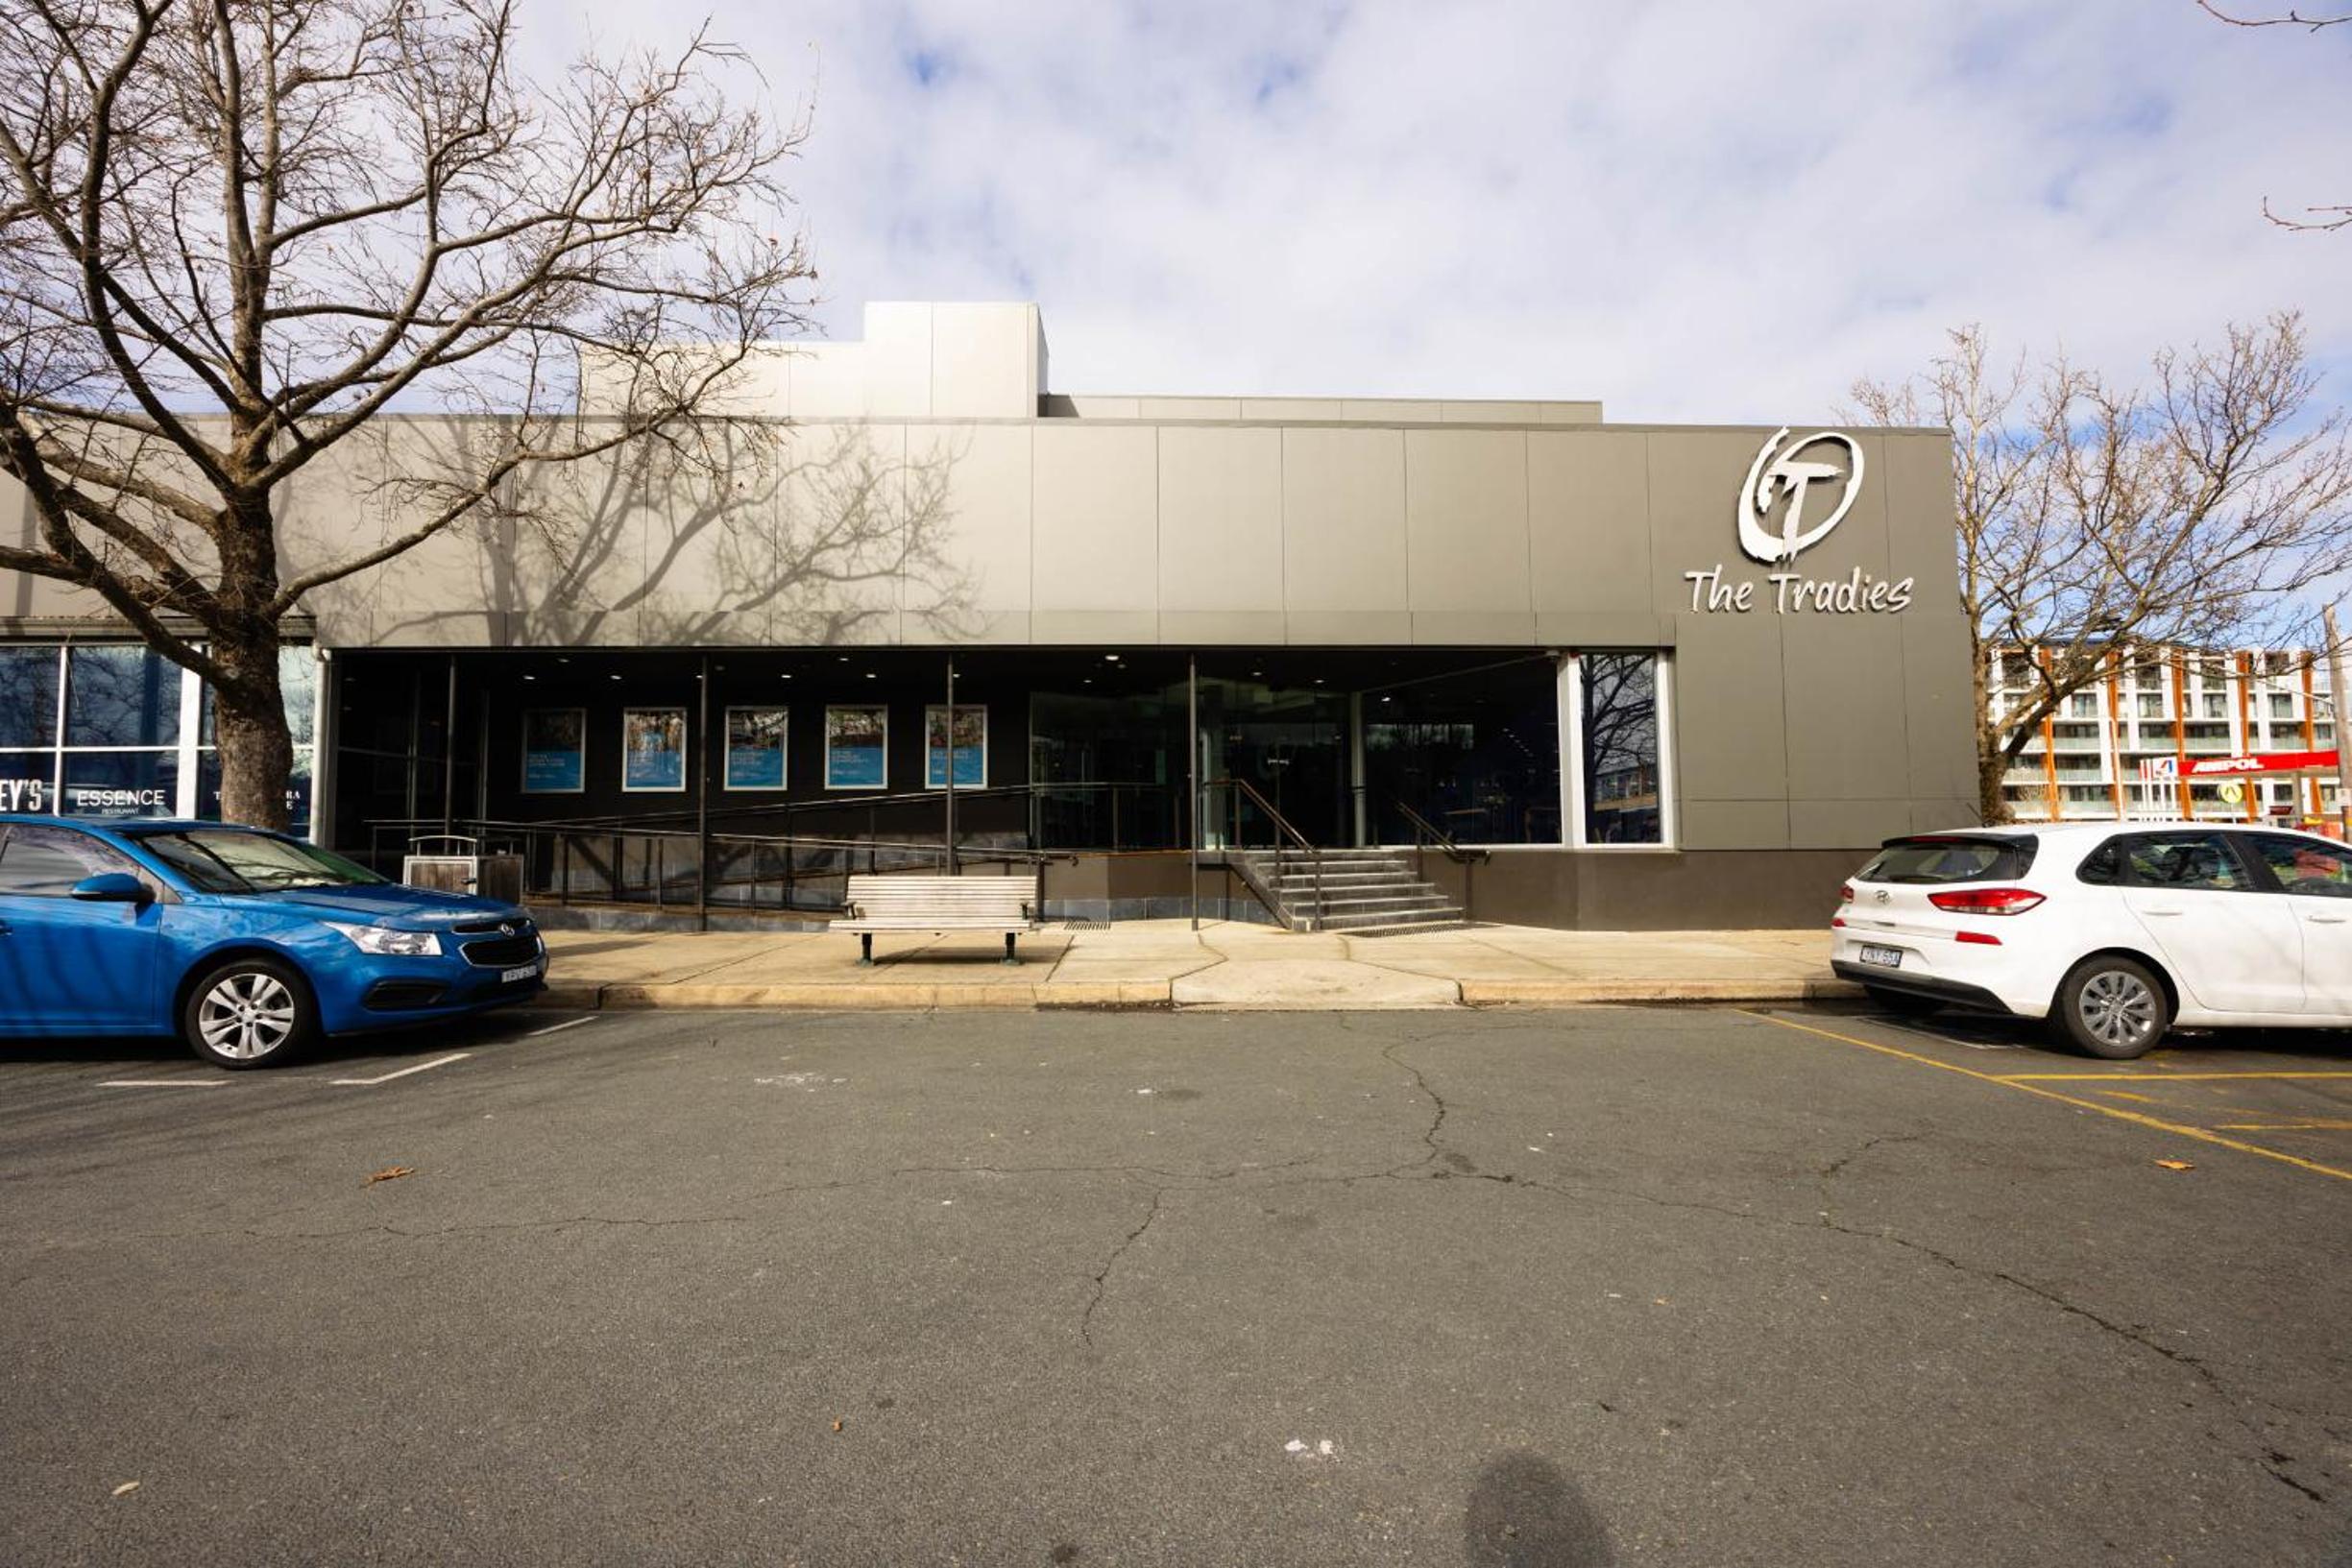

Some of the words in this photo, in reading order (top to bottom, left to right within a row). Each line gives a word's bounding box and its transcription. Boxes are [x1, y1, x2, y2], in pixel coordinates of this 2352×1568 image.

[1685, 565, 1754, 613] The
[1768, 567, 1914, 614] Tradies
[2191, 759, 2265, 774] AMPOL
[77, 789, 166, 807] ESSENCE
